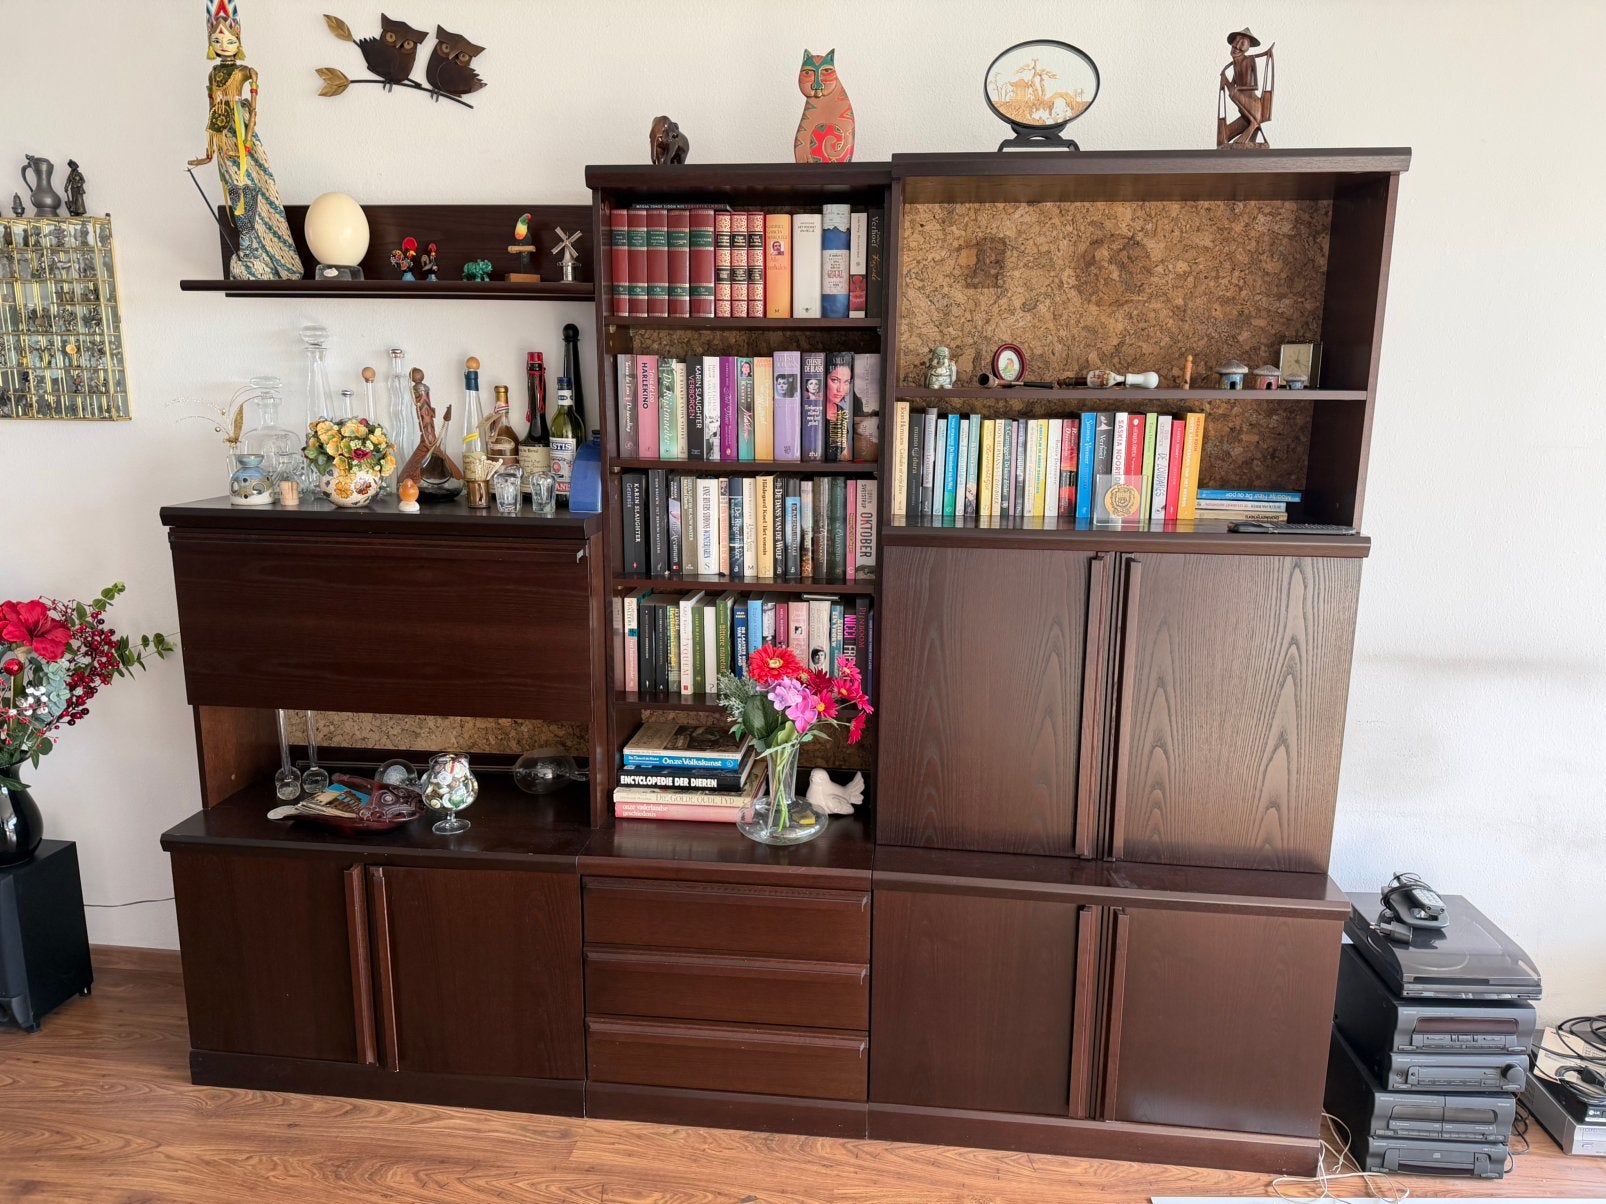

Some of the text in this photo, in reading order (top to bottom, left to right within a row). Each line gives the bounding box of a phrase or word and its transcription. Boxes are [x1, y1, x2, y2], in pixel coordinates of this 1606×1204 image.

[870, 216, 880, 248] Verhoef
[641, 362, 649, 410] HARLEKINO
[688, 375, 696, 419] VERBORGEN
[662, 373, 673, 446] De Rijstmoeder
[995, 421, 1003, 440] TOON
[1117, 419, 1125, 447] SASKIA
[550, 442, 572, 451] STIS
[912, 426, 921, 475] mano dura
[1084, 443, 1094, 465] Vermeer
[1098, 434, 1107, 460] Verhoef
[1114, 448, 1122, 475] NOORT
[732, 506, 743, 559] De Regenmaker
[775, 488, 784, 560] DE DANS VAN DE WOLF
[859, 512, 873, 558] OKTOBER
[741, 626, 747, 634] DE
[844, 614, 857, 638] NICCI
[682, 643, 690, 678] YQUEM
[662, 757, 722, 769] Onze Volkskunst
[620, 775, 718, 788] ENCYCLOPEDIE DER DIEREN
[638, 803, 669, 812] vaderlandse
